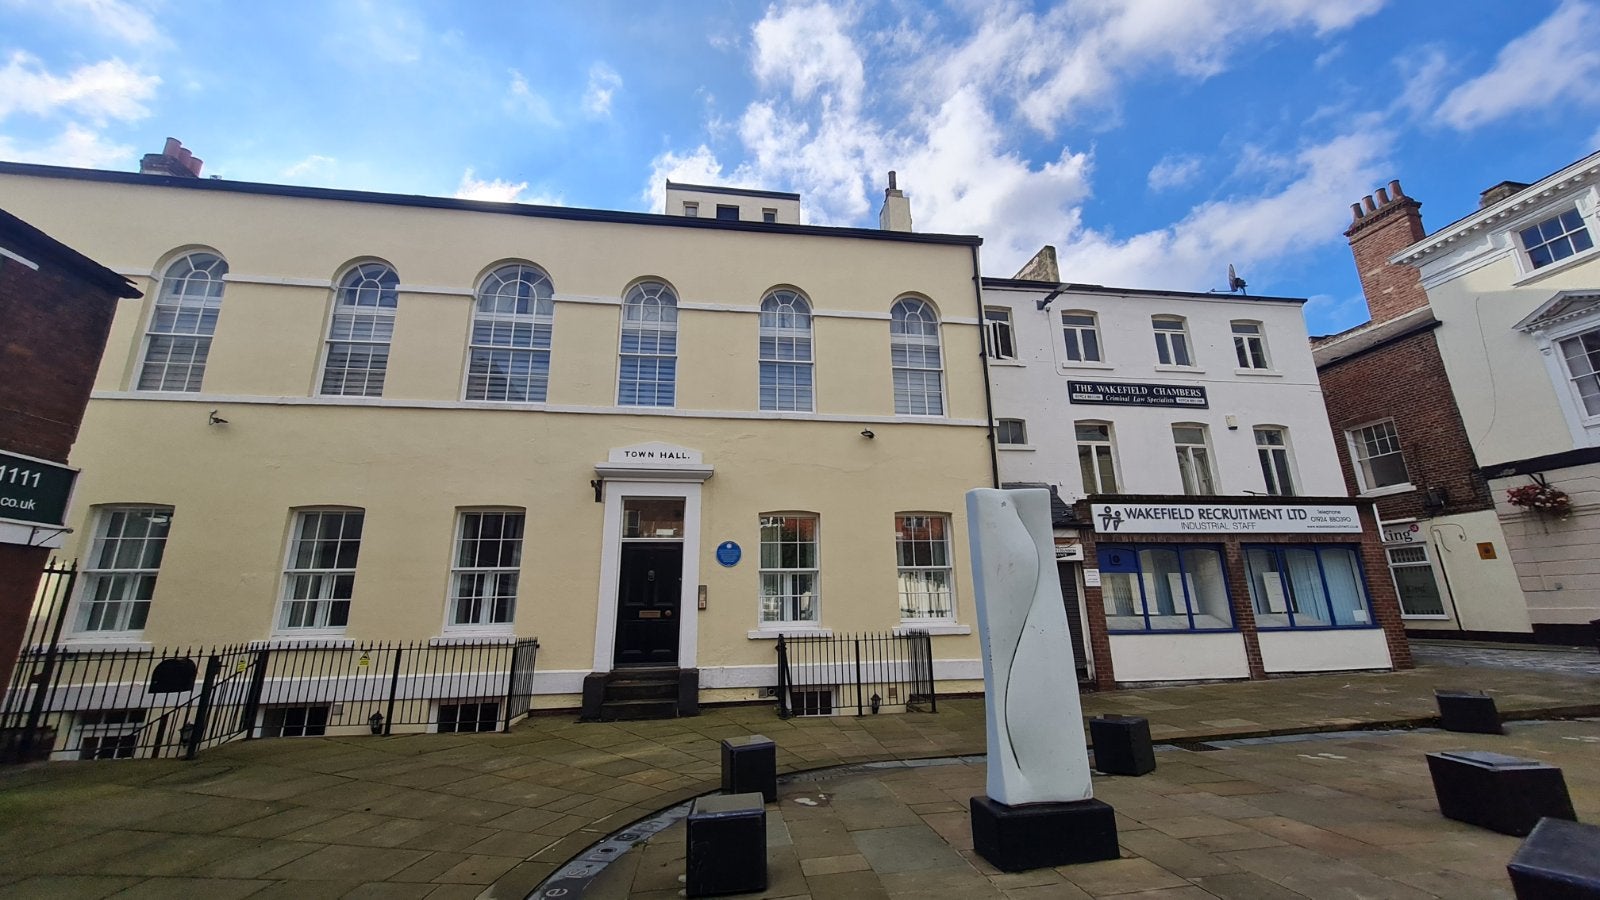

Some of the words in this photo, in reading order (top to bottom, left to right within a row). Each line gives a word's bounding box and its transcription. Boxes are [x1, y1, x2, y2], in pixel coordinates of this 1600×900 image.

[1075, 384, 1093, 392] THE
[1097, 385, 1148, 394] WAKEFIELD
[1154, 387, 1202, 396] CHAMBERS
[1124, 508, 1194, 520] WAKEFIELD
[1198, 508, 1282, 520] RECRUITMENT
[1287, 509, 1307, 520] LTD
[1181, 522, 1229, 530] INDUSTRIAL
